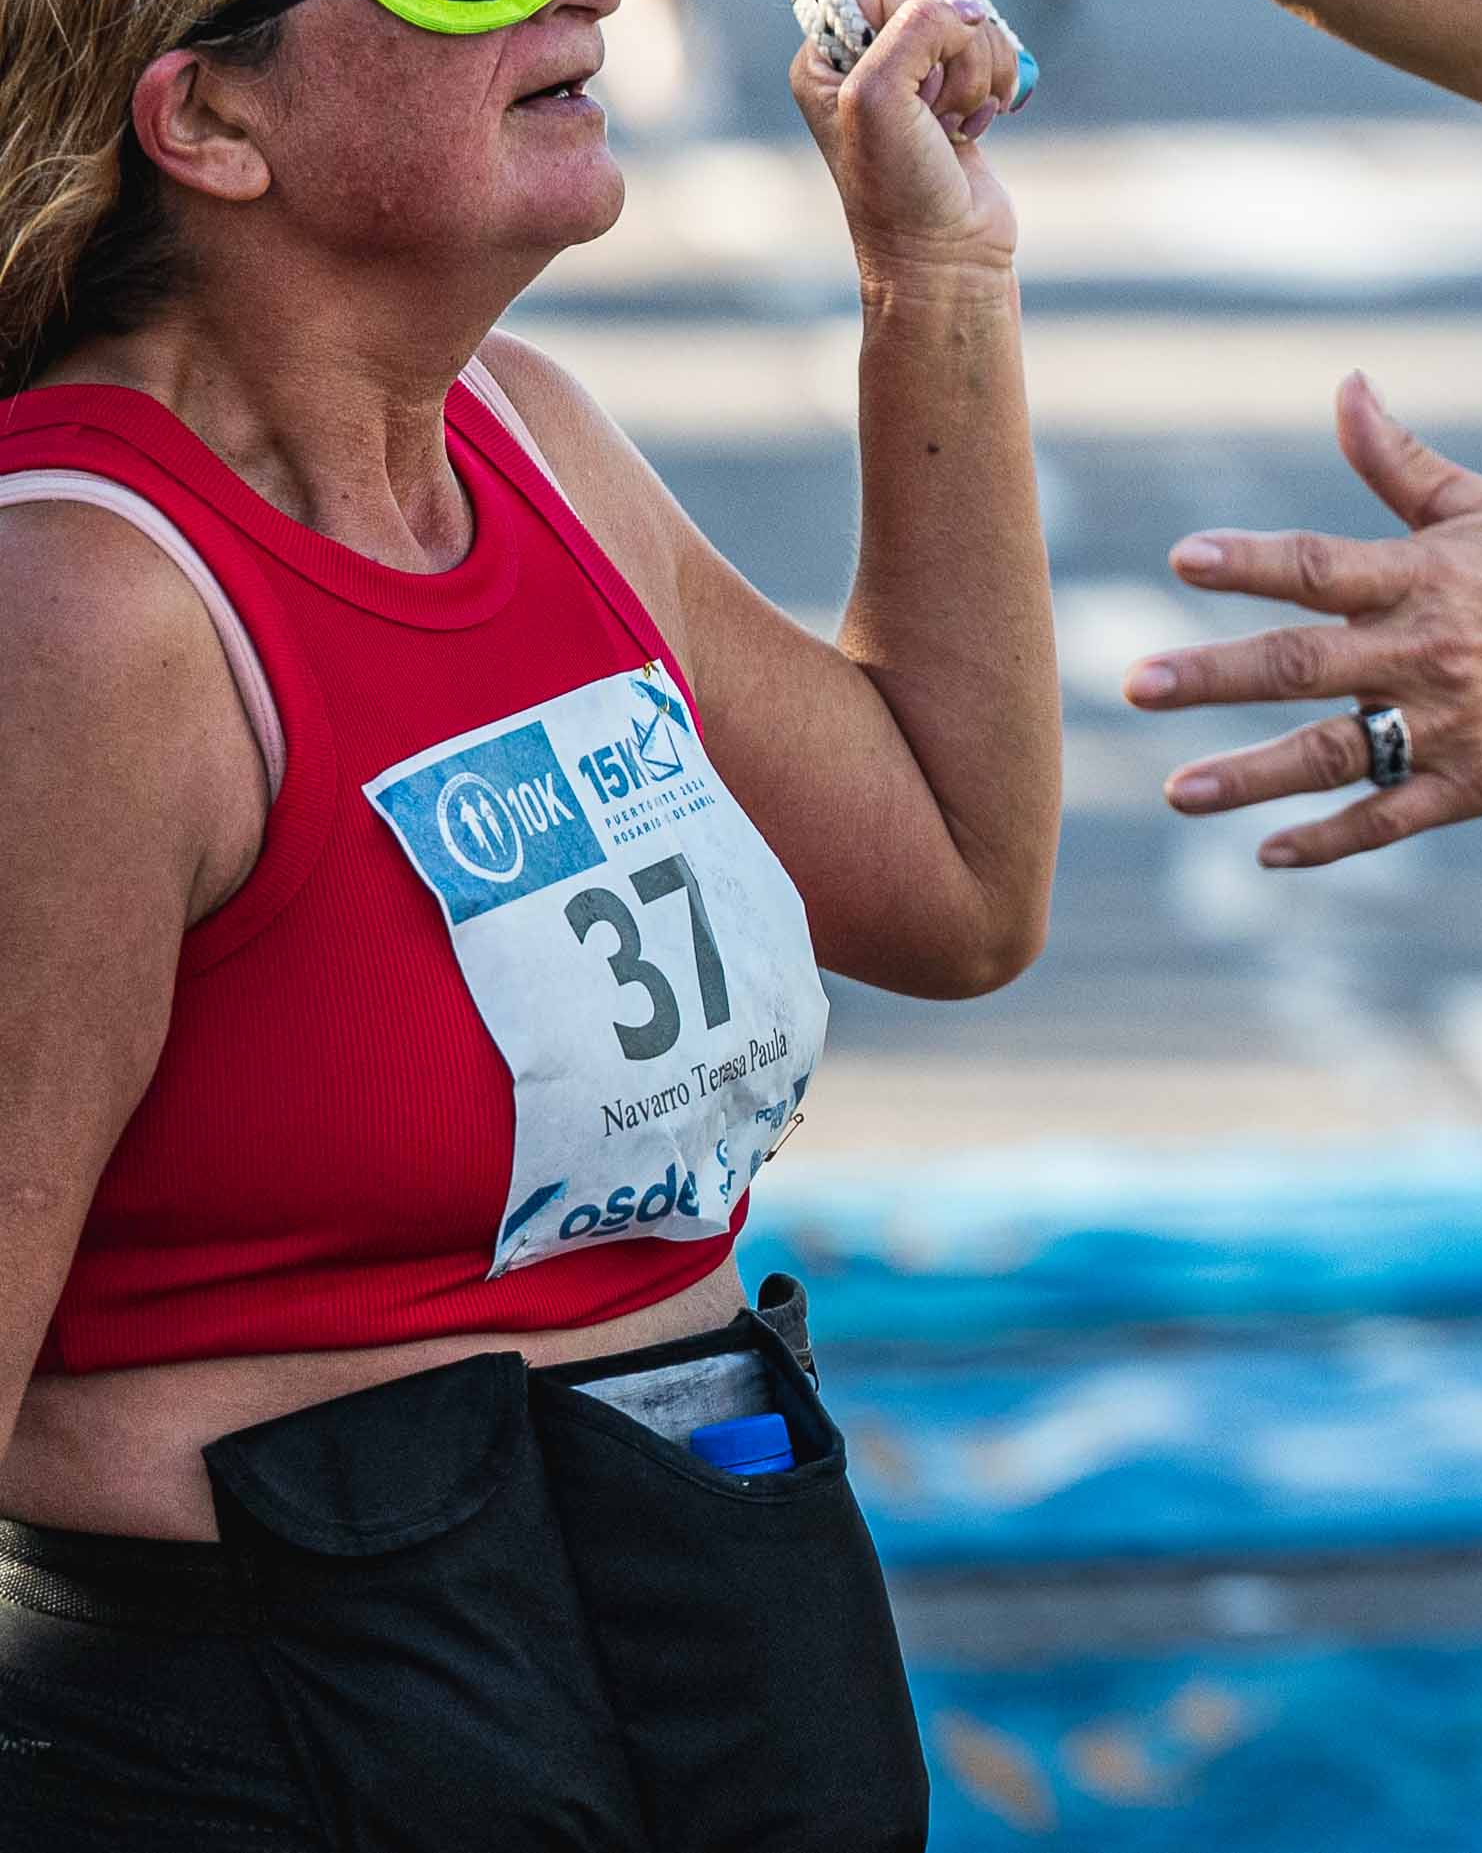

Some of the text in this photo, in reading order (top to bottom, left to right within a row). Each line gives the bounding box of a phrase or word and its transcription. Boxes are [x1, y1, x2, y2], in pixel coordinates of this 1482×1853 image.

[507, 772, 575, 837] 10K
[563, 852, 731, 1062] 37
[601, 1027, 788, 1137] Navarro Teresa Paula
